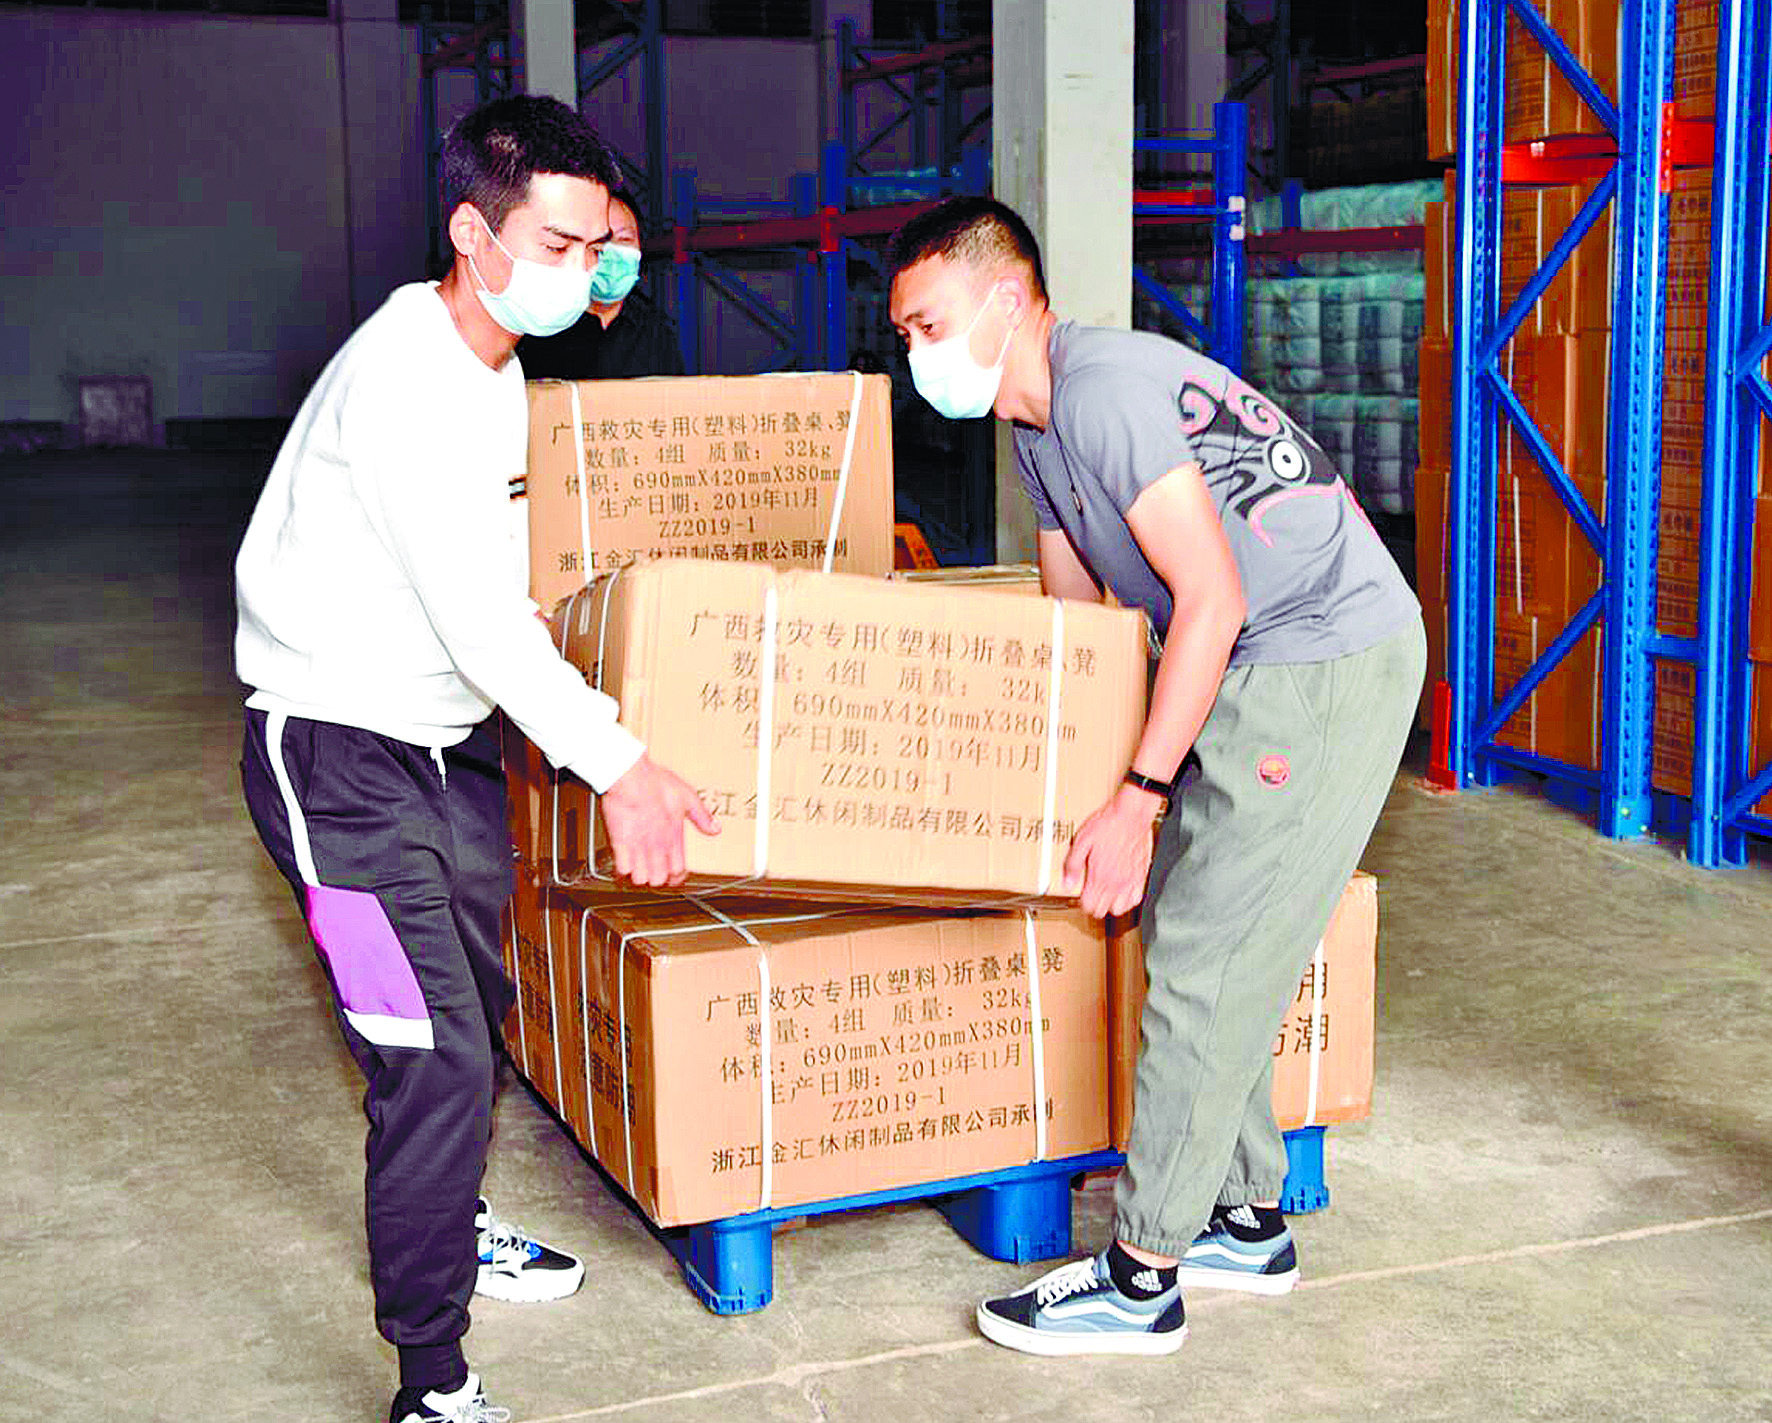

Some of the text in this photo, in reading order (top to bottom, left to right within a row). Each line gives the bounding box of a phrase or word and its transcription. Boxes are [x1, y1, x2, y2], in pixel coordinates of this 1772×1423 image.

[784, 439, 833, 461] 32kg
[659, 515, 755, 539] ZZ2019-1
[1001, 676, 1061, 709] 32k
[820, 762, 951, 795] ZZ2019-1
[706, 947, 1065, 1022] 广西救灾专用(塑料)折叠桌凳
[832, 1086, 946, 1123] ZZ2019-1
